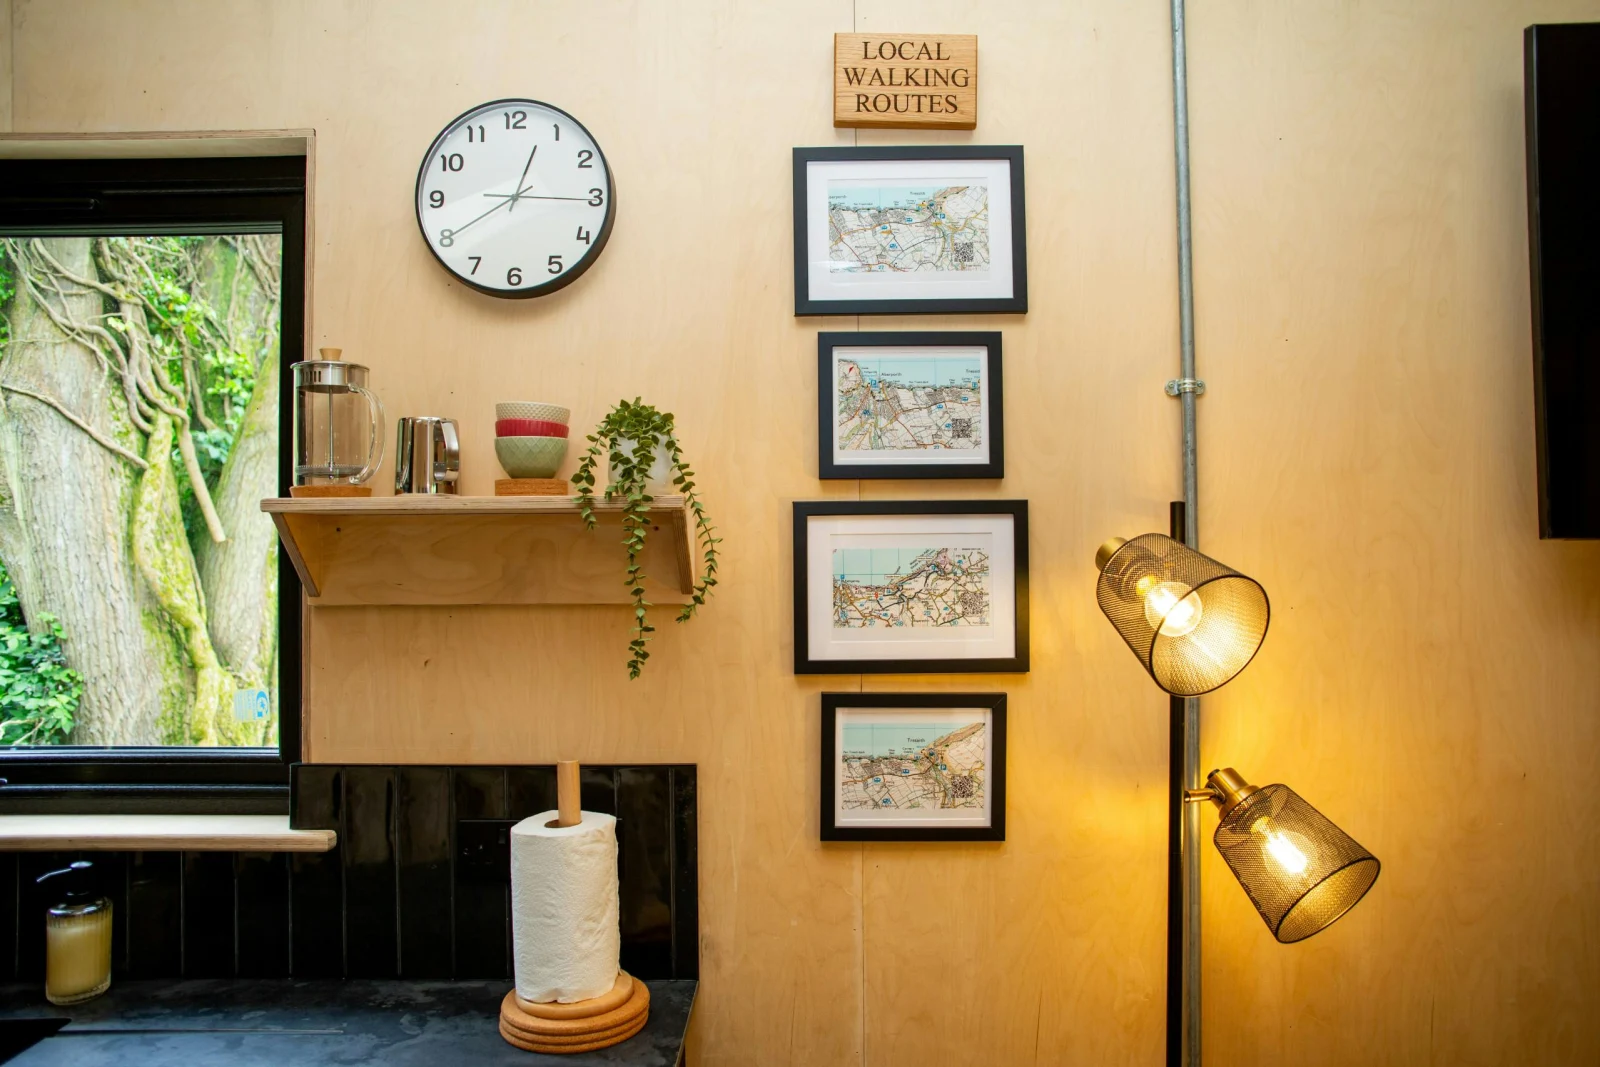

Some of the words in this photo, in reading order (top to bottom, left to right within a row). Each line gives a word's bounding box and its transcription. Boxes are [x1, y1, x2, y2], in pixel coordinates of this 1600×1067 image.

[862, 41, 951, 61] LOCAL
[842, 67, 971, 88] WALKING
[855, 93, 958, 114] ROUTES
[503, 110, 527, 130] 12
[466, 124, 485, 143] 11
[553, 123, 560, 141] 1
[440, 153, 464, 172] 10
[577, 149, 593, 169] 2
[429, 190, 445, 209] 9
[587, 187, 604, 207] 3
[439, 228, 454, 248] 8
[576, 226, 591, 245] 4
[467, 256, 482, 275] 7
[547, 255, 563, 274] 5
[506, 267, 523, 286] 6
